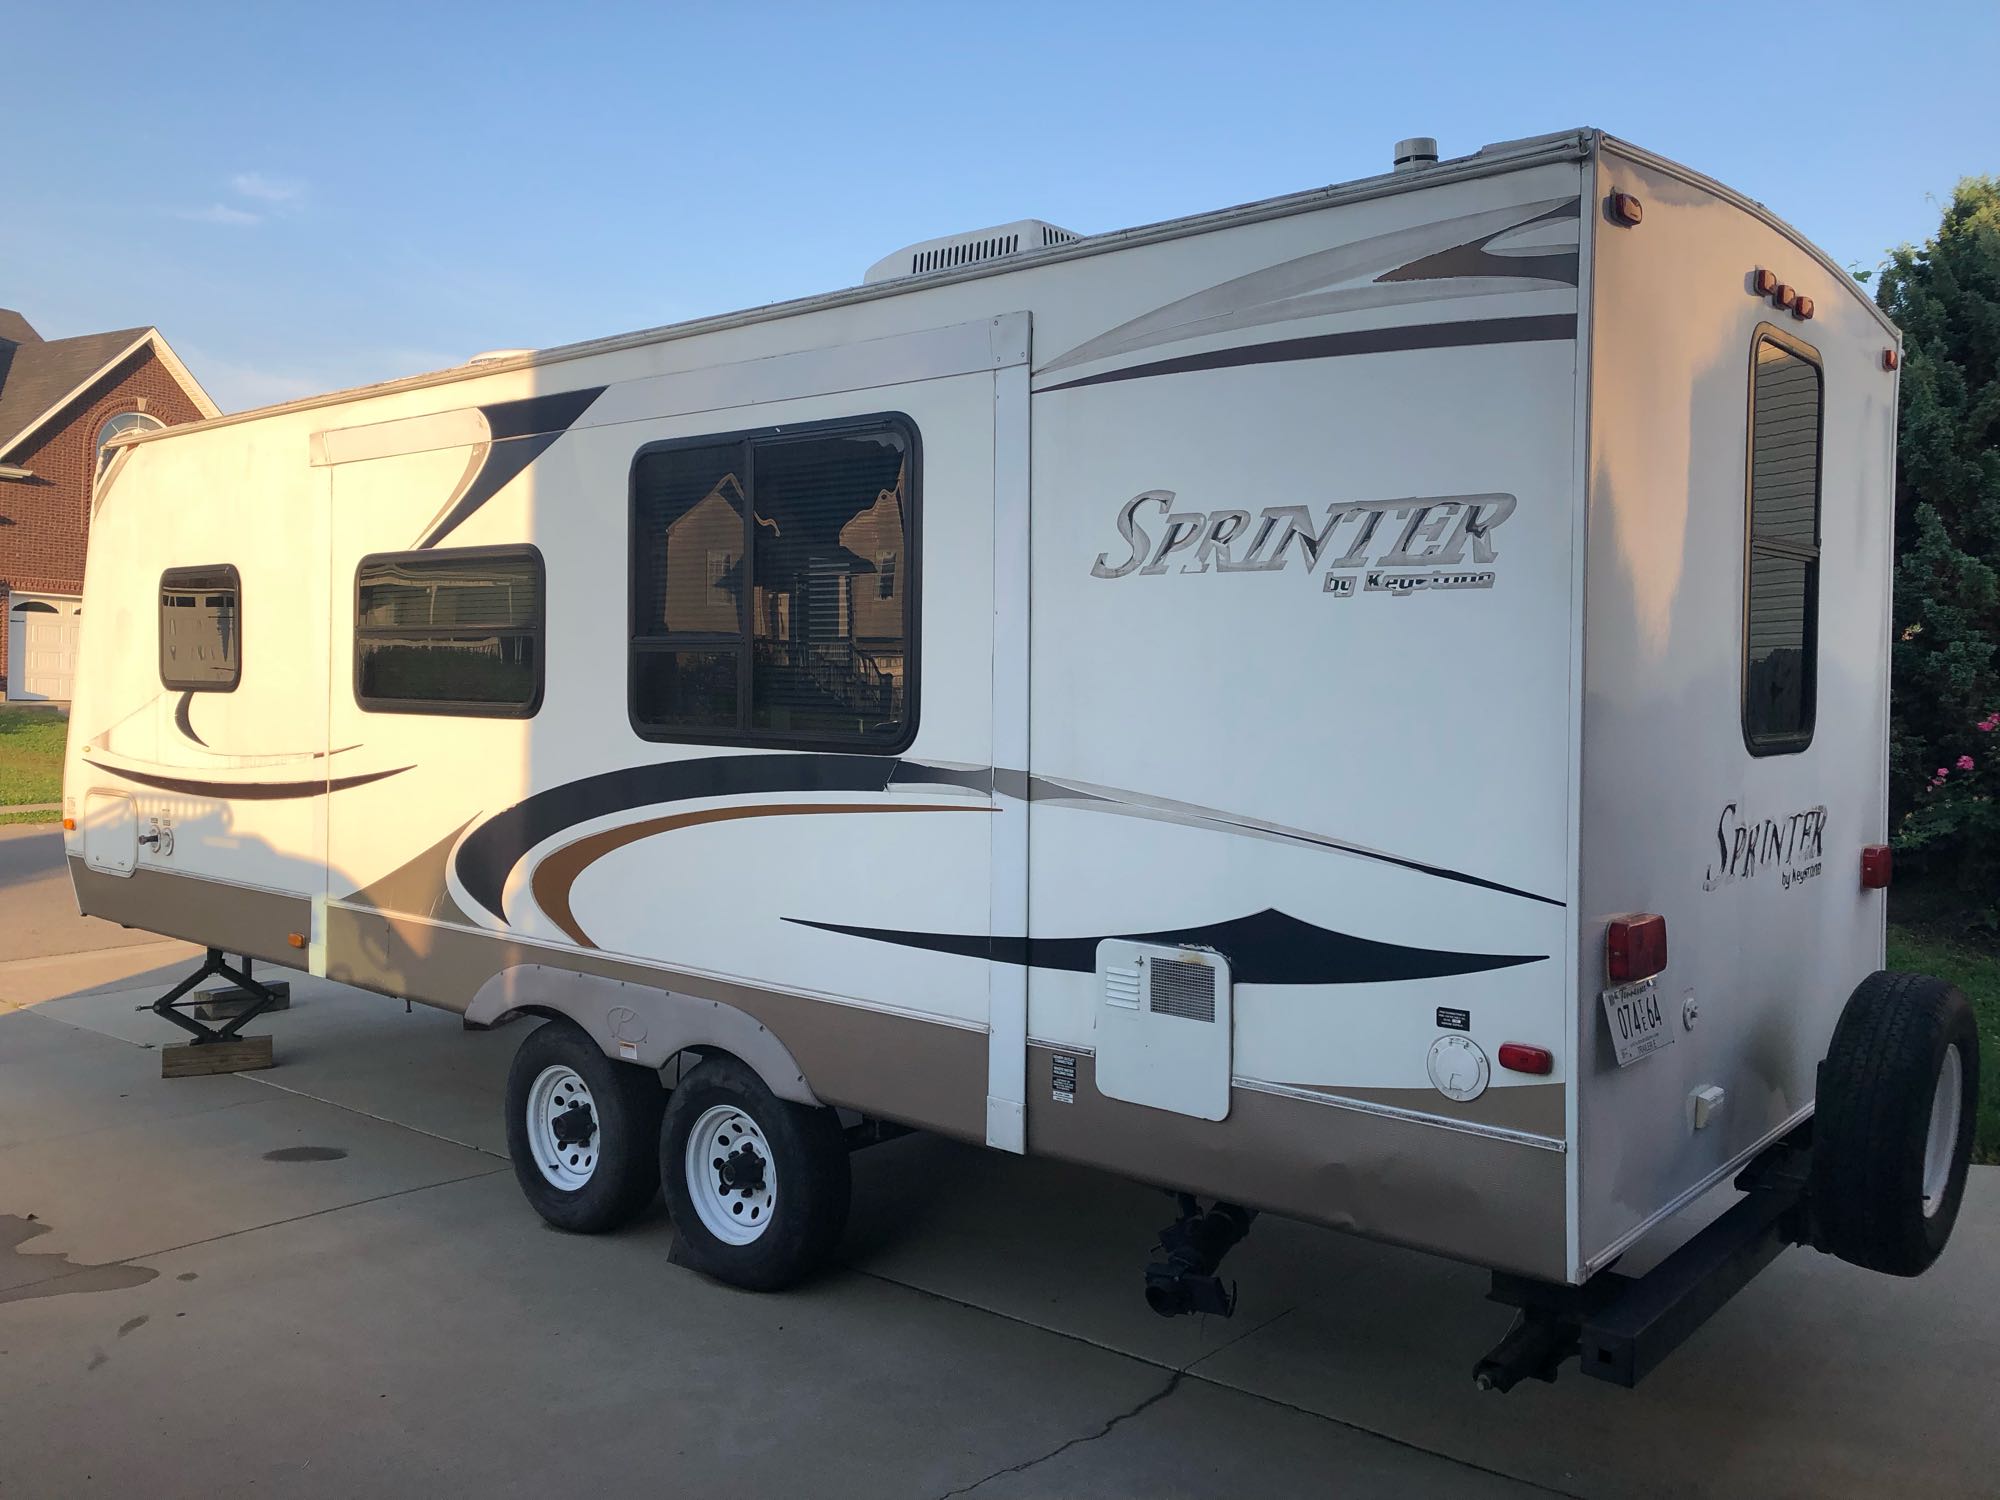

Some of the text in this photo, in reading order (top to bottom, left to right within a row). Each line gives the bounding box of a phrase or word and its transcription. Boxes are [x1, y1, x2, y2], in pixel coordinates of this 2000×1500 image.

[1090, 489, 1517, 579] SPRINTER
[1322, 572, 1357, 598] by
[1702, 803, 1827, 892] SPRINTER
